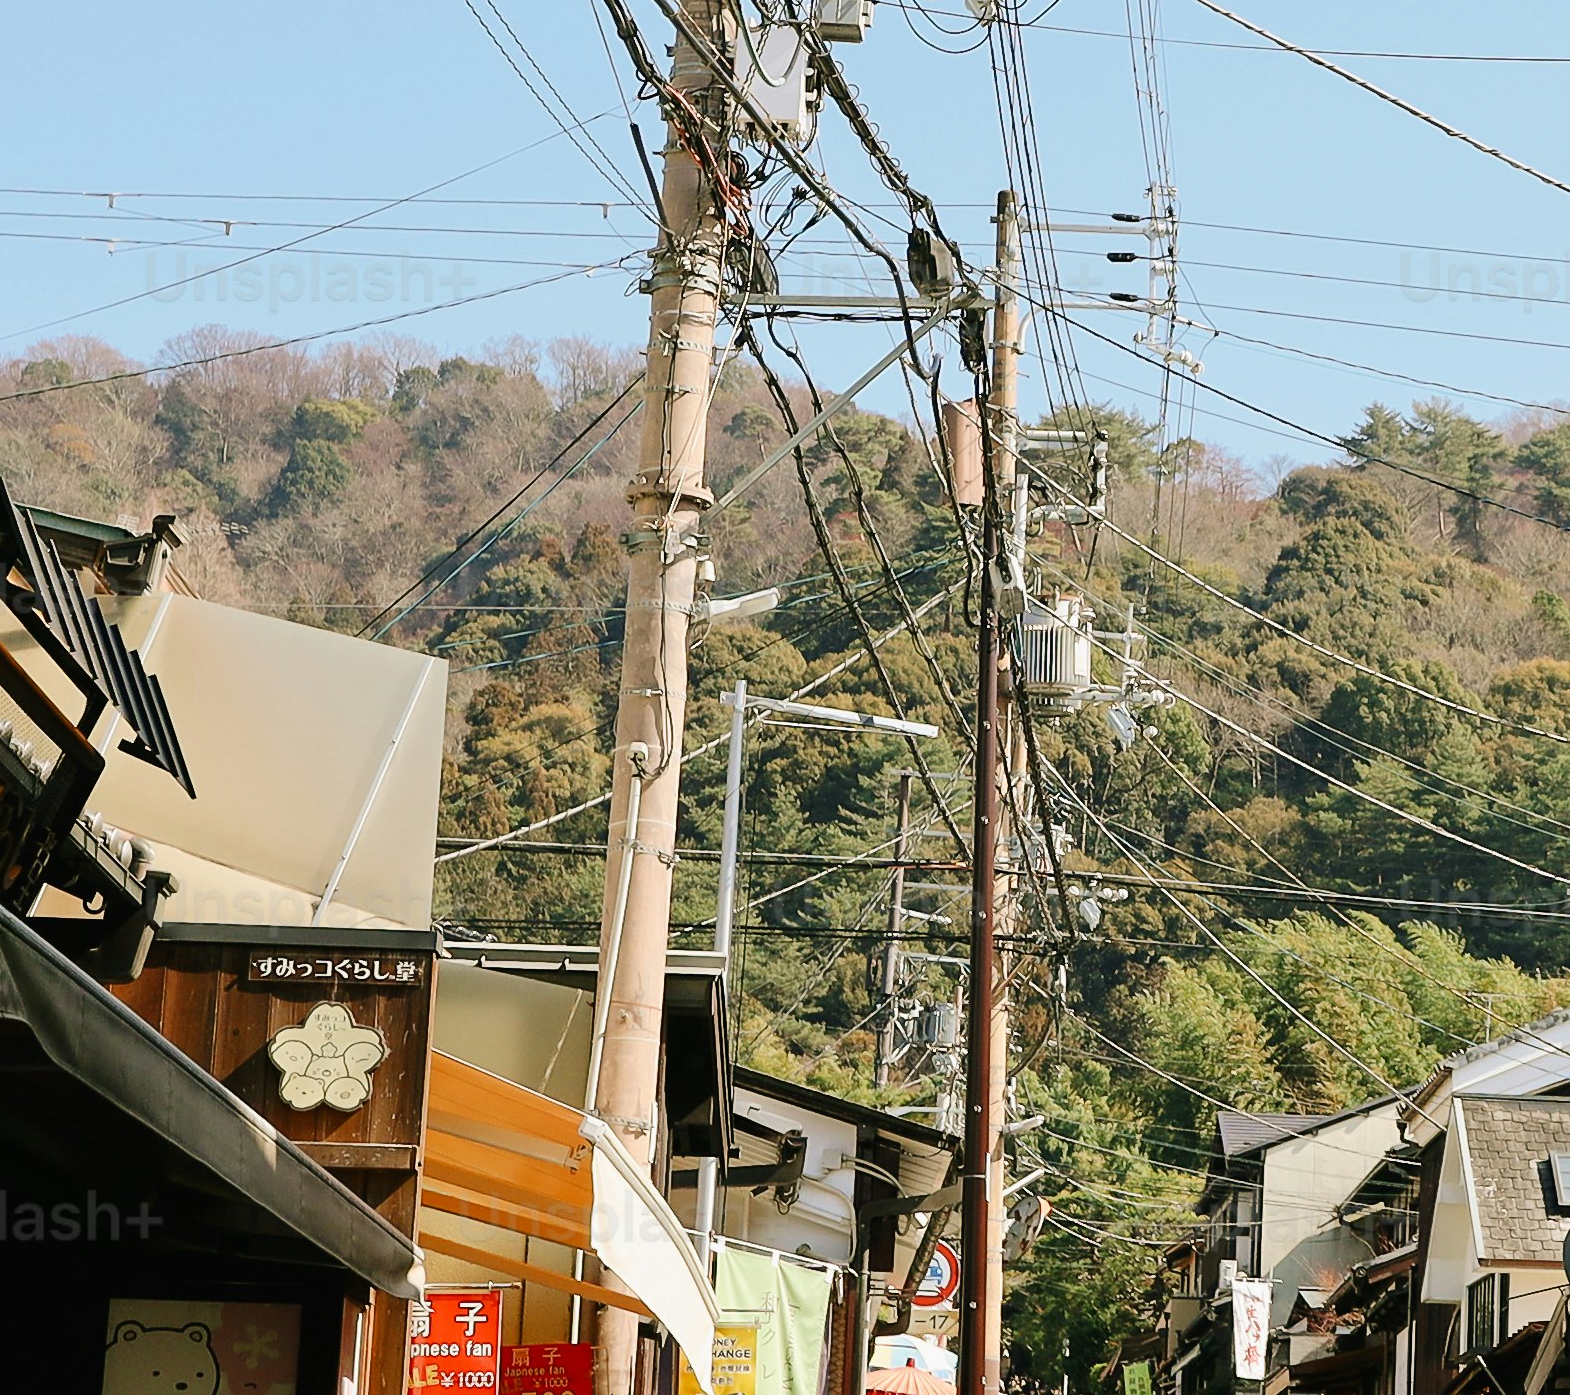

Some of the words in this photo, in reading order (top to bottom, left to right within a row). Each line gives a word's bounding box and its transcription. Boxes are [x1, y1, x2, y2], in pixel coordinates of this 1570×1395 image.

[466, 1340, 493, 1357] fan
[511, 1347, 562, 1367] 扇子
[549, 1366, 566, 1376] fan
